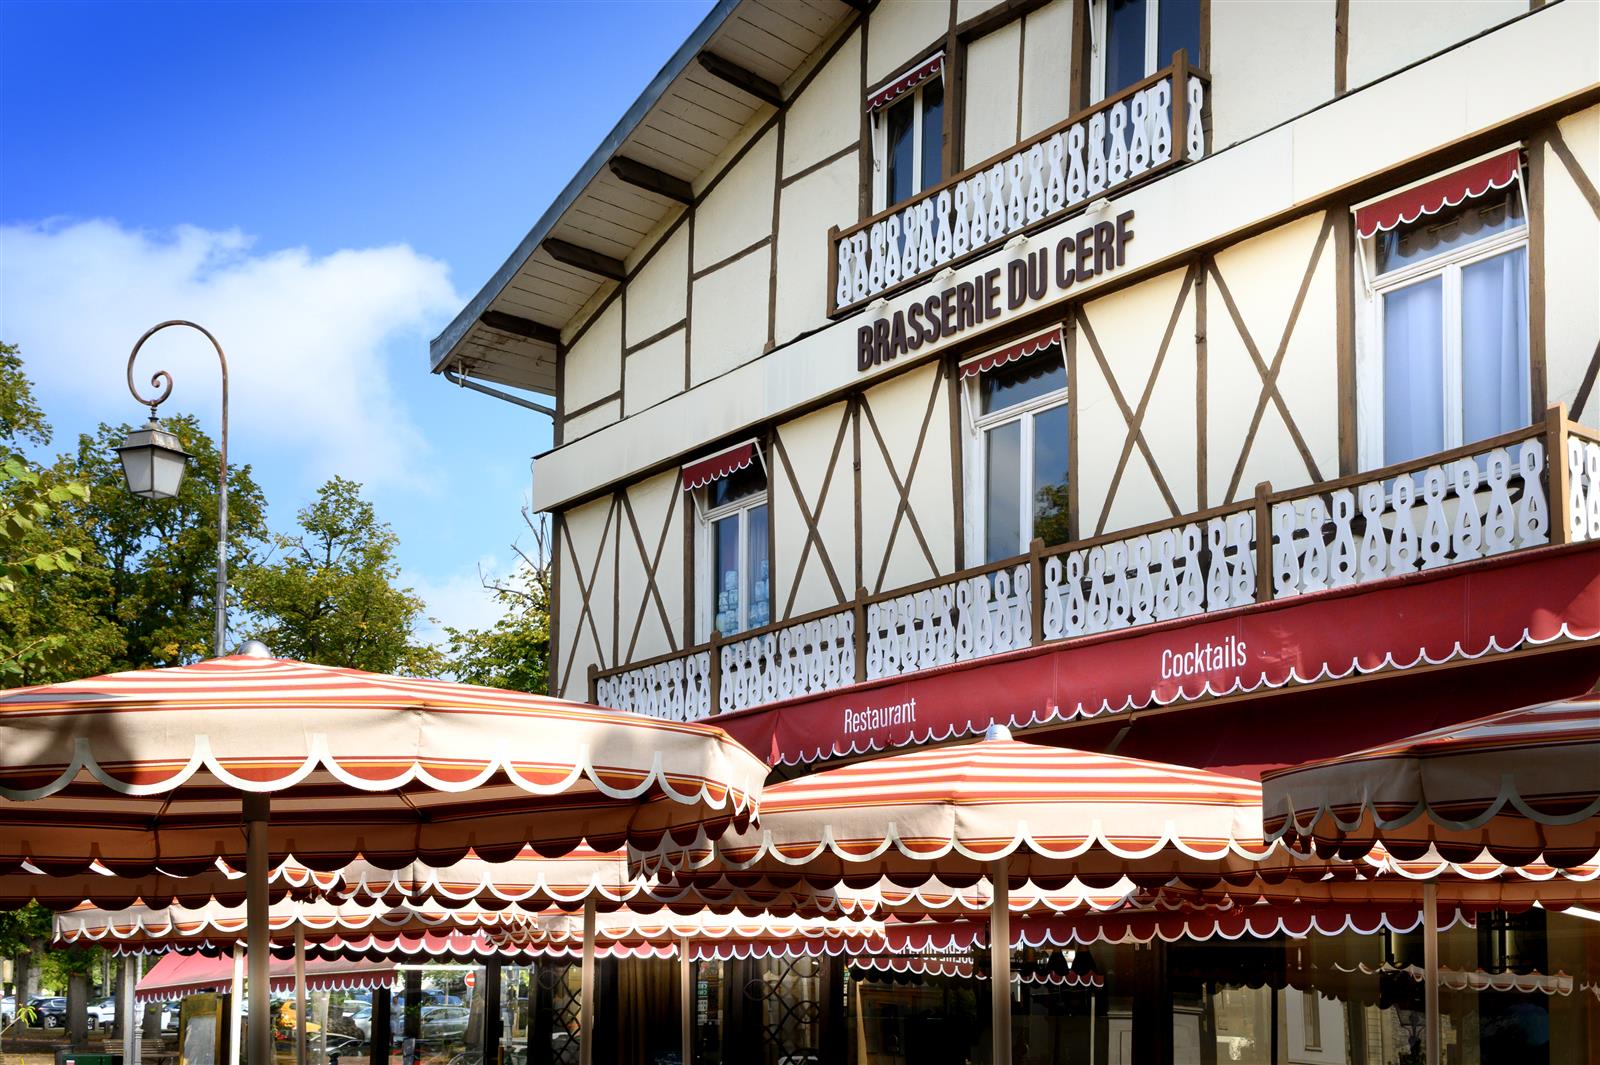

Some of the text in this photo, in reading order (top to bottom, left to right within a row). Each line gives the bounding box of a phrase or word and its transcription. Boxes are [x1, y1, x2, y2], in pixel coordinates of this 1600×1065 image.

[857, 209, 1135, 372] BRASSERIE DU CERF
[1161, 635, 1247, 679] Cocktails
[844, 697, 916, 734] Restaurant
